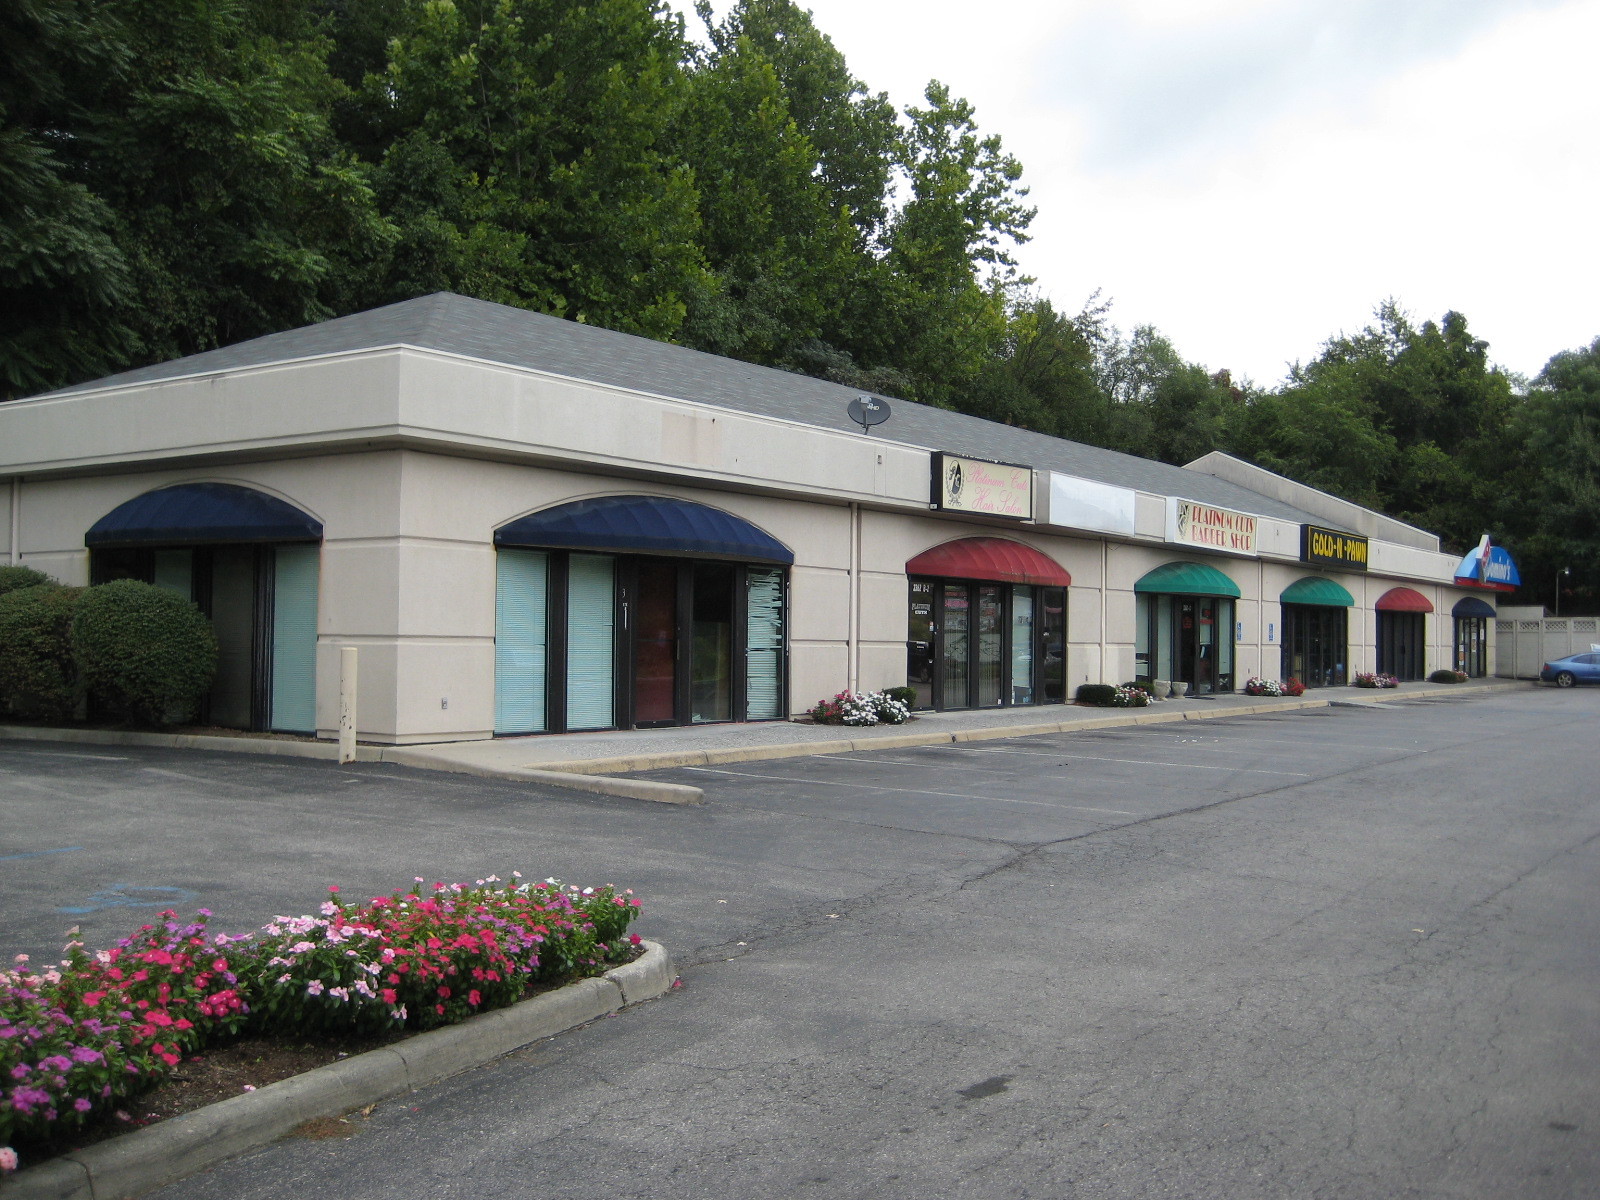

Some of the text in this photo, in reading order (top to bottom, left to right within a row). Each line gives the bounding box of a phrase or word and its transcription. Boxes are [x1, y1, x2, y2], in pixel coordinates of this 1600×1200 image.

[966, 461, 1028, 491] Platinum Cuts
[972, 486, 1023, 515] Hair Salon
[1192, 506, 1254, 534] PLATINUM CUTS
[1191, 525, 1252, 551] BARBER SHOP
